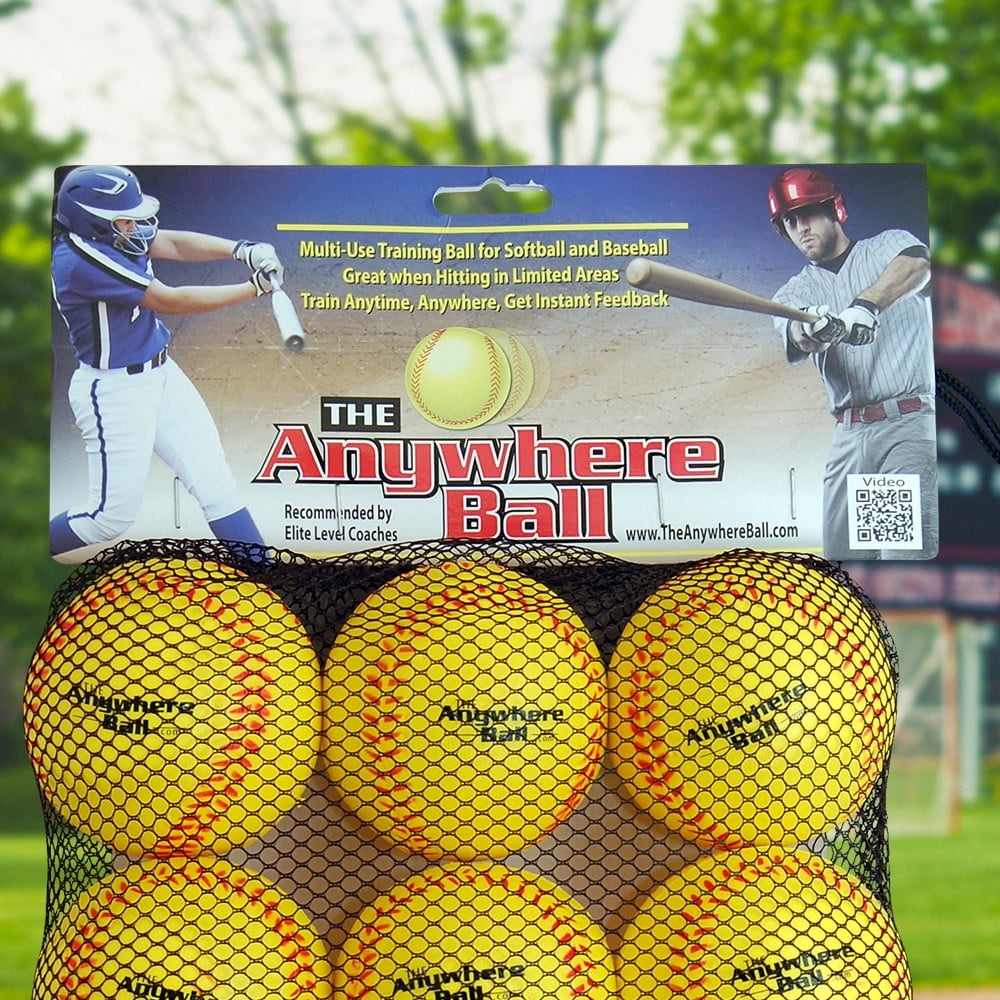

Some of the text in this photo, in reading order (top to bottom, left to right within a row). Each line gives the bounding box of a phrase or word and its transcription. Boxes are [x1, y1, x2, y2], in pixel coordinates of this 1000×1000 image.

[300, 238, 669, 264] Multi-Use Training Ball for Softball and Baseball
[342, 266, 620, 289] Great when Hitting in Limited Areas
[300, 289, 670, 315] Train Anytime, Anywhere, Get Instant Feedback
[323, 402, 395, 426] THE
[251, 423, 725, 498] Anywhere
[862, 476, 905, 488] Video
[377, 504, 393, 525] by
[440, 482, 619, 543] Ball
[284, 525, 398, 542] Elite Level Coaches
[626, 521, 799, 544] www.TheAnywhereBall.com
[68, 687, 196, 714] Anywhere
[103, 714, 150, 735] Ball
[438, 705, 564, 726] Anywhere
[687, 682, 806, 746] Anywhere
[481, 726, 527, 742] Ball
[730, 719, 780, 750] Ball
[732, 946, 856, 983] Anywhere
[393, 965, 525, 995] Anywhere
[776, 969, 823, 993] Ball
